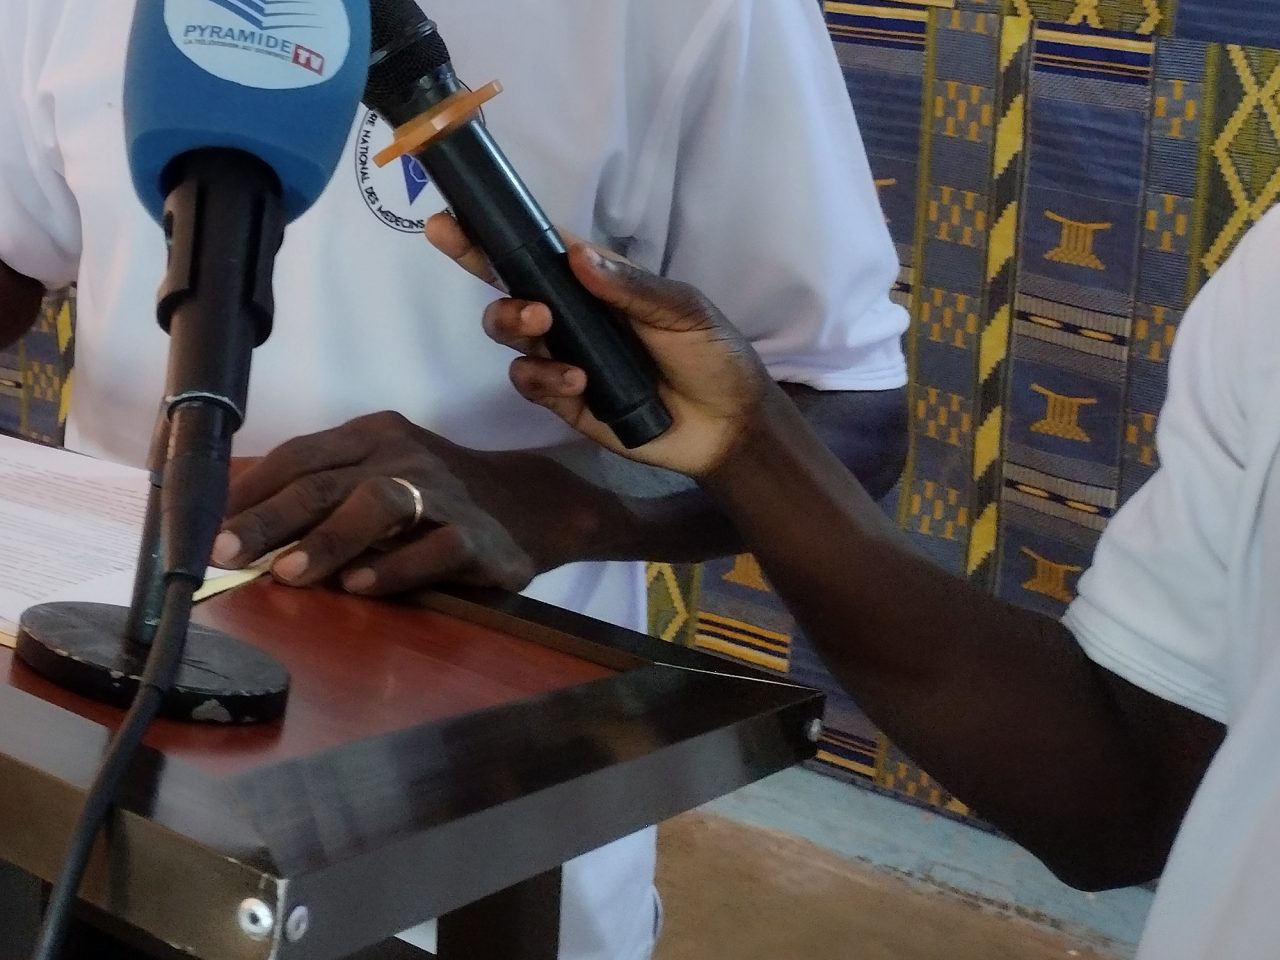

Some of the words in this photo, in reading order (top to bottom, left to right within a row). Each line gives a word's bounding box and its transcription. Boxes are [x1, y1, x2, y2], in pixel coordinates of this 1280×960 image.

[183, 24, 292, 55] PYRAMIDE
[359, 129, 372, 184] NATIONAL
[365, 186, 380, 206] DES
